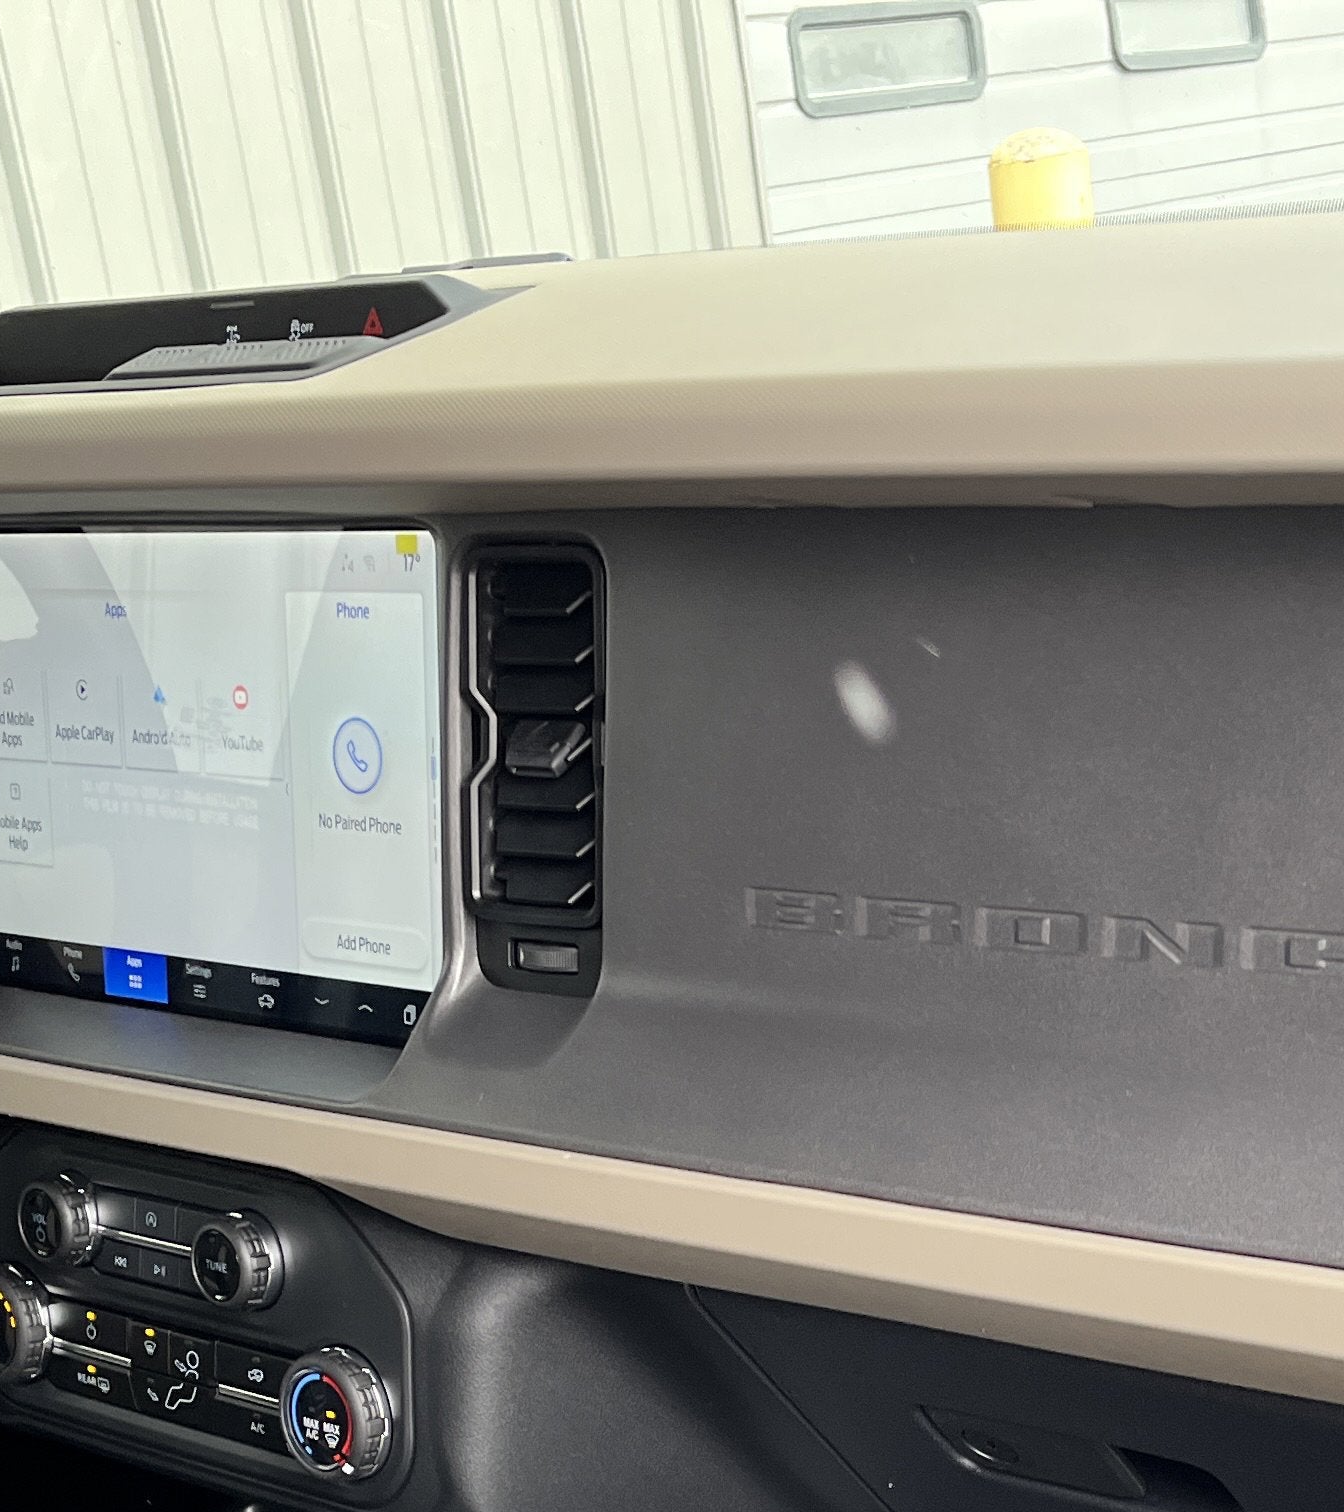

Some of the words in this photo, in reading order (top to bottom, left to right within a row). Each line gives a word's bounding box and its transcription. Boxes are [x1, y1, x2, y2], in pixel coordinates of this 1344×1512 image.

[300, 323, 314, 334] OFF
[105, 602, 127, 619] Apps
[336, 602, 370, 619] Phone
[6, 711, 35, 727] Mobile
[2, 731, 23, 747] Apps
[55, 724, 80, 741] Apple
[80, 726, 115, 744] CarPlay
[132, 730, 168, 746] Android
[222, 735, 264, 751] YouTube
[21, 817, 42, 833] Apps
[318, 813, 332, 829] No
[335, 814, 366, 832] Paired
[369, 817, 402, 835] Phone
[8, 835, 28, 852] Help
[337, 934, 356, 951] Add
[358, 936, 391, 955] Phone
[205, 1258, 228, 1275] TUNE
[77, 1372, 97, 1387] REAR
[250, 1421, 266, 1435] A/C
[303, 1416, 319, 1430] MAX
[323, 1422, 340, 1436] MAX
[306, 1428, 319, 1440] A/C
